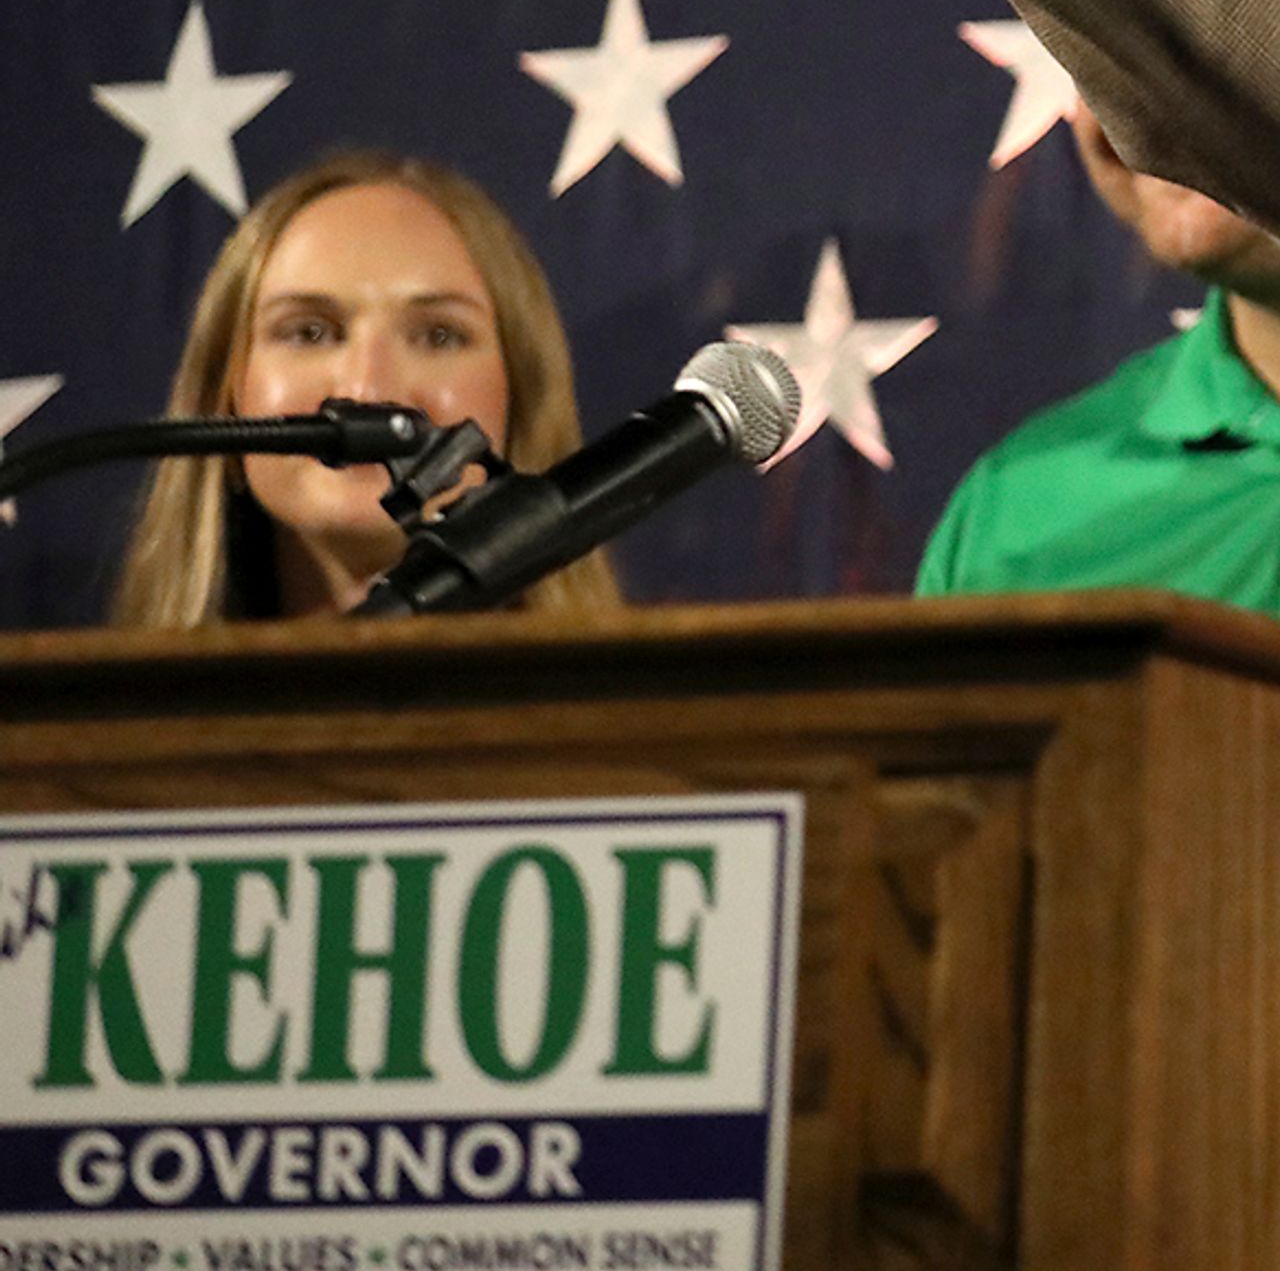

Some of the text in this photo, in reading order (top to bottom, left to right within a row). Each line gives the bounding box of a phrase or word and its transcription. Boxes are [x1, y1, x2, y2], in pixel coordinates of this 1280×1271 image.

[32, 843, 717, 1090] KEHOE
[58, 1122, 584, 1206] GOVERNOR
[202, 1235, 356, 1271] VALUES
[400, 1232, 590, 1271] COMMON
[603, 1229, 717, 1269] SENSE
